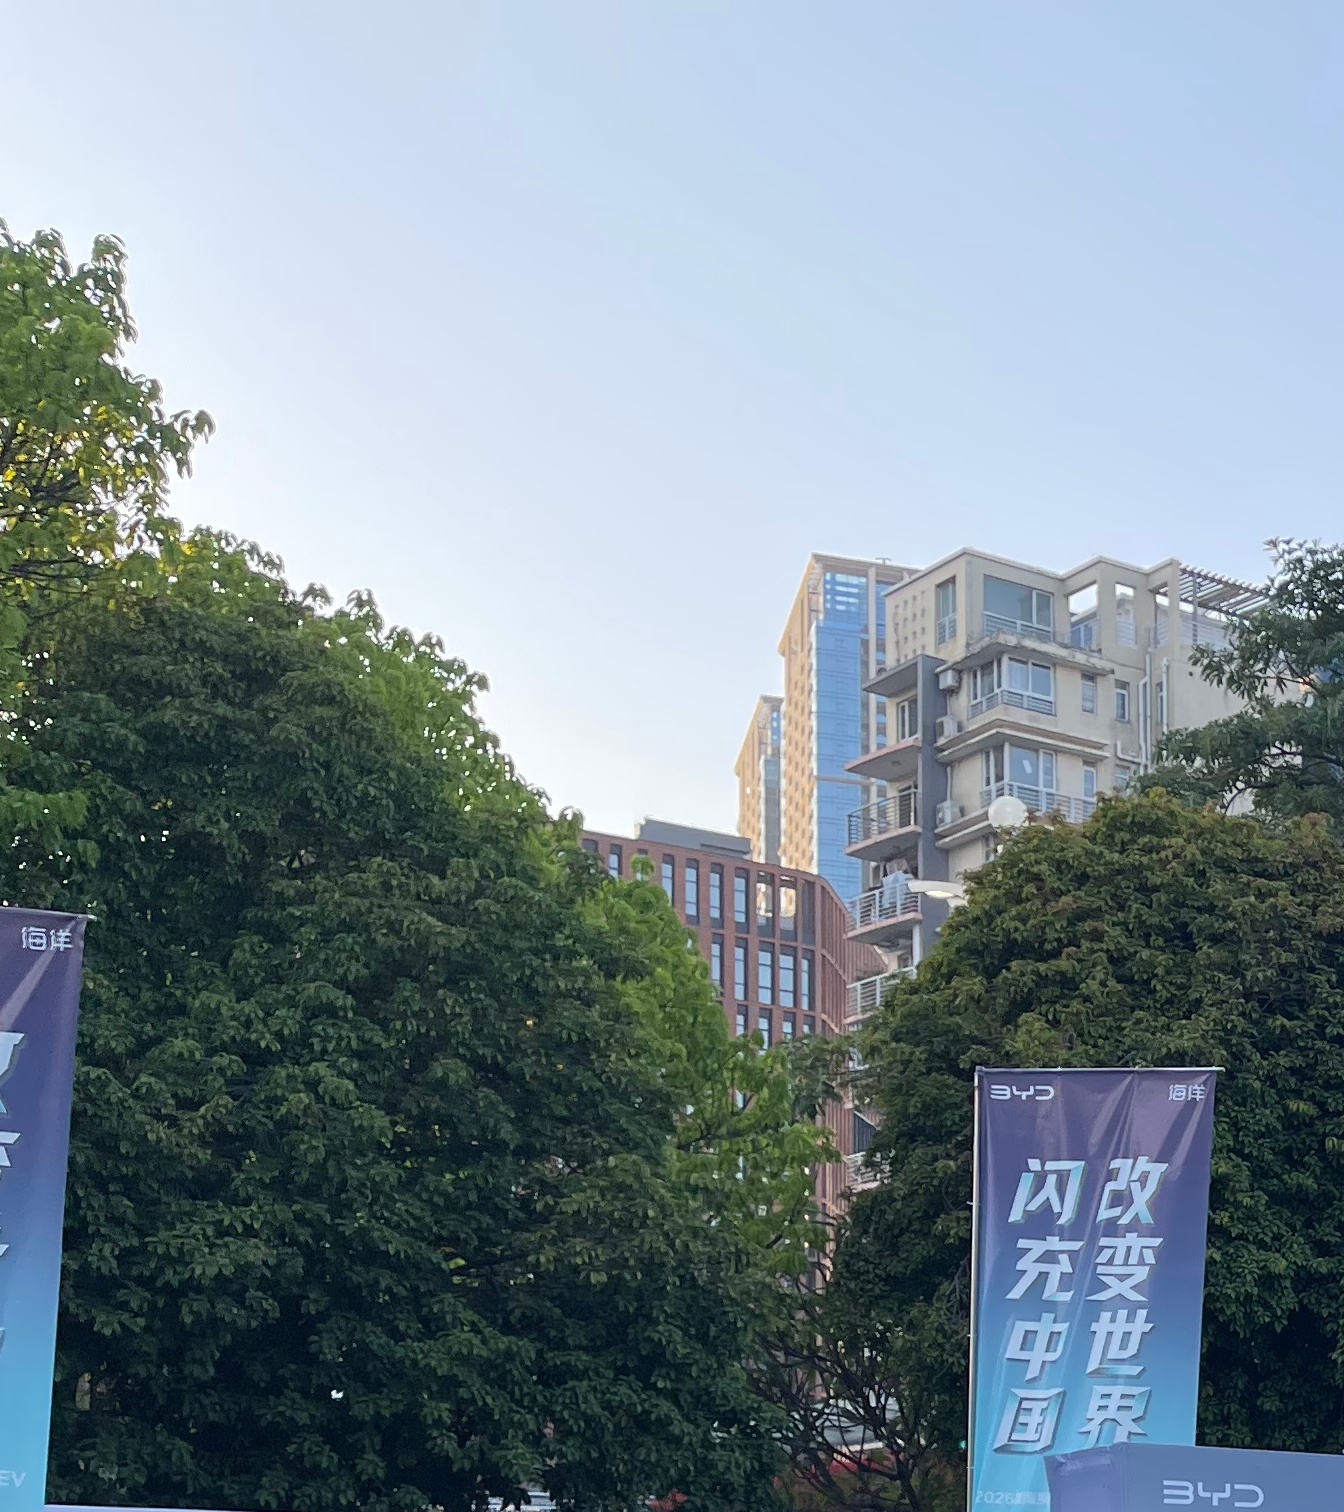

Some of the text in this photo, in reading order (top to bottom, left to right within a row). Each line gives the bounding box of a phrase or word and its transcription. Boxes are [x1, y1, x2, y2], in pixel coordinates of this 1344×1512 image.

[21, 926, 73, 951] 海洋
[989, 1084, 1055, 1100] BYD
[1168, 1084, 1206, 1102] 海洋
[992, 1157, 1087, 1454] 闪充中国
[1077, 1156, 1169, 1446] 改变世界
[1163, 1480, 1264, 1508] BYD
